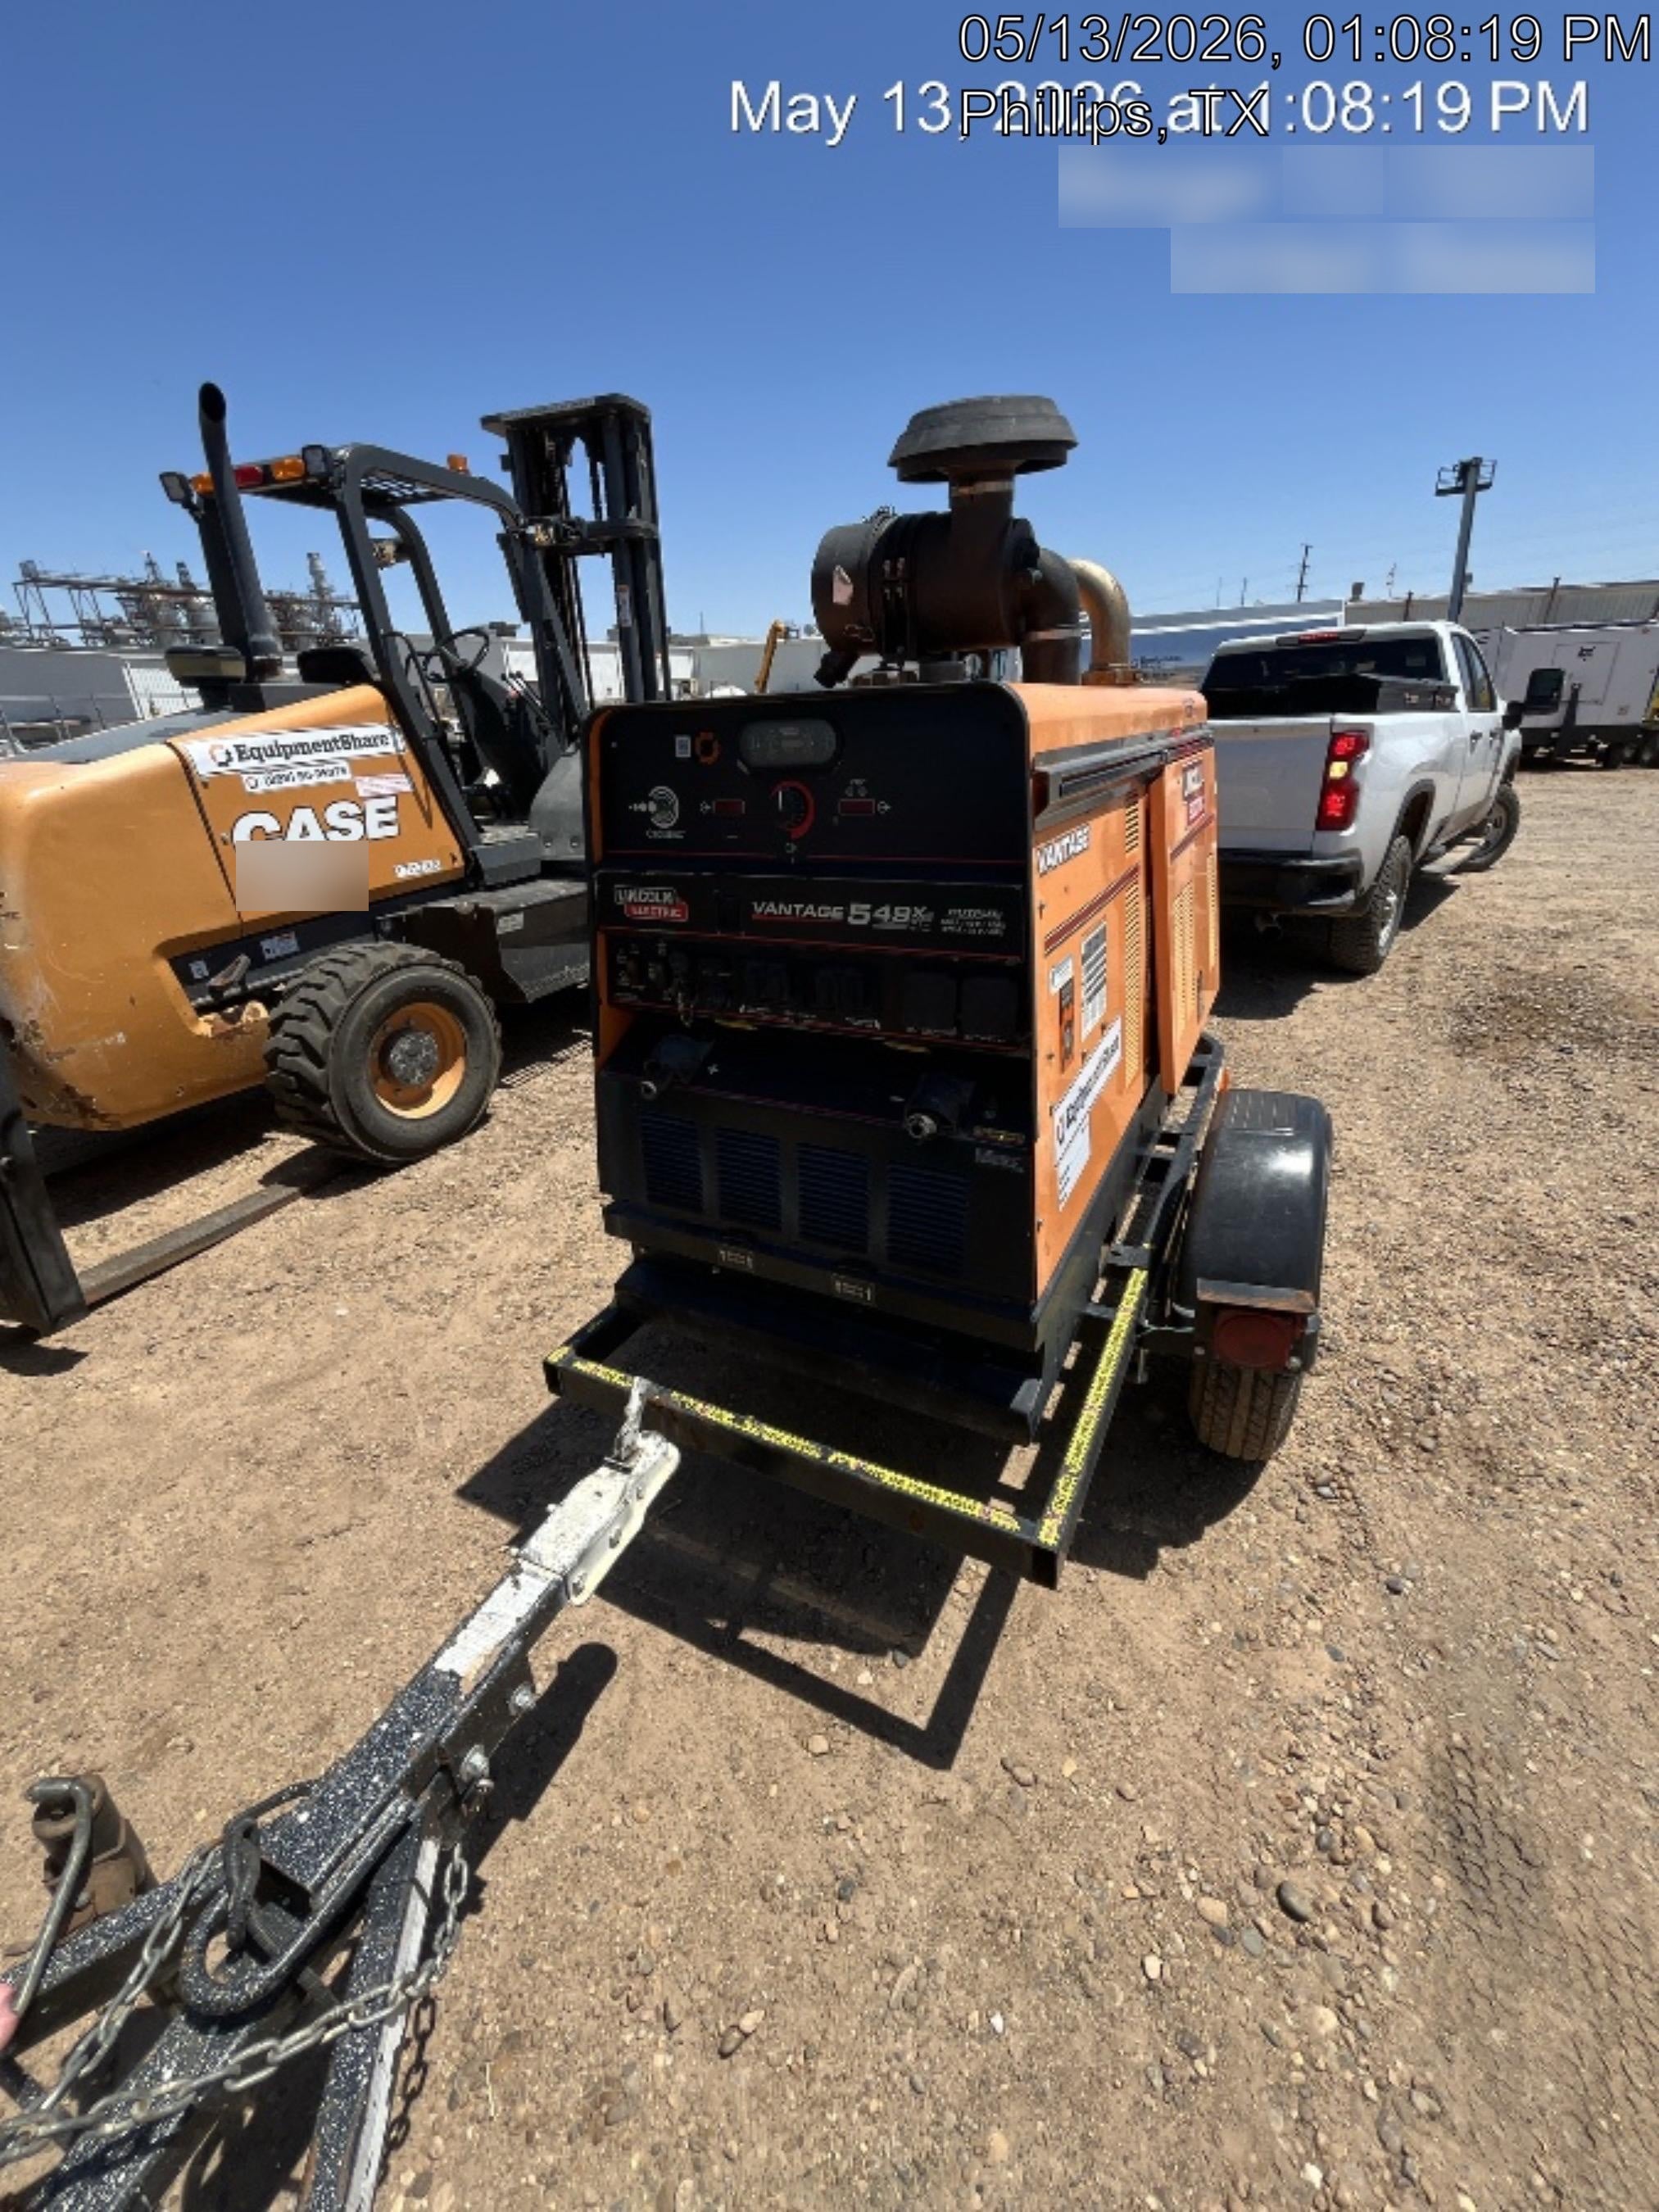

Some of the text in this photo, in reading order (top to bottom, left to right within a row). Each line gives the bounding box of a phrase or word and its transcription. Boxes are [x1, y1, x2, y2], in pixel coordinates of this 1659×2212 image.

[233, 734, 389, 762] EquipmentShare
[232, 795, 400, 842] CASE
[752, 902, 845, 920] VANTAGE
